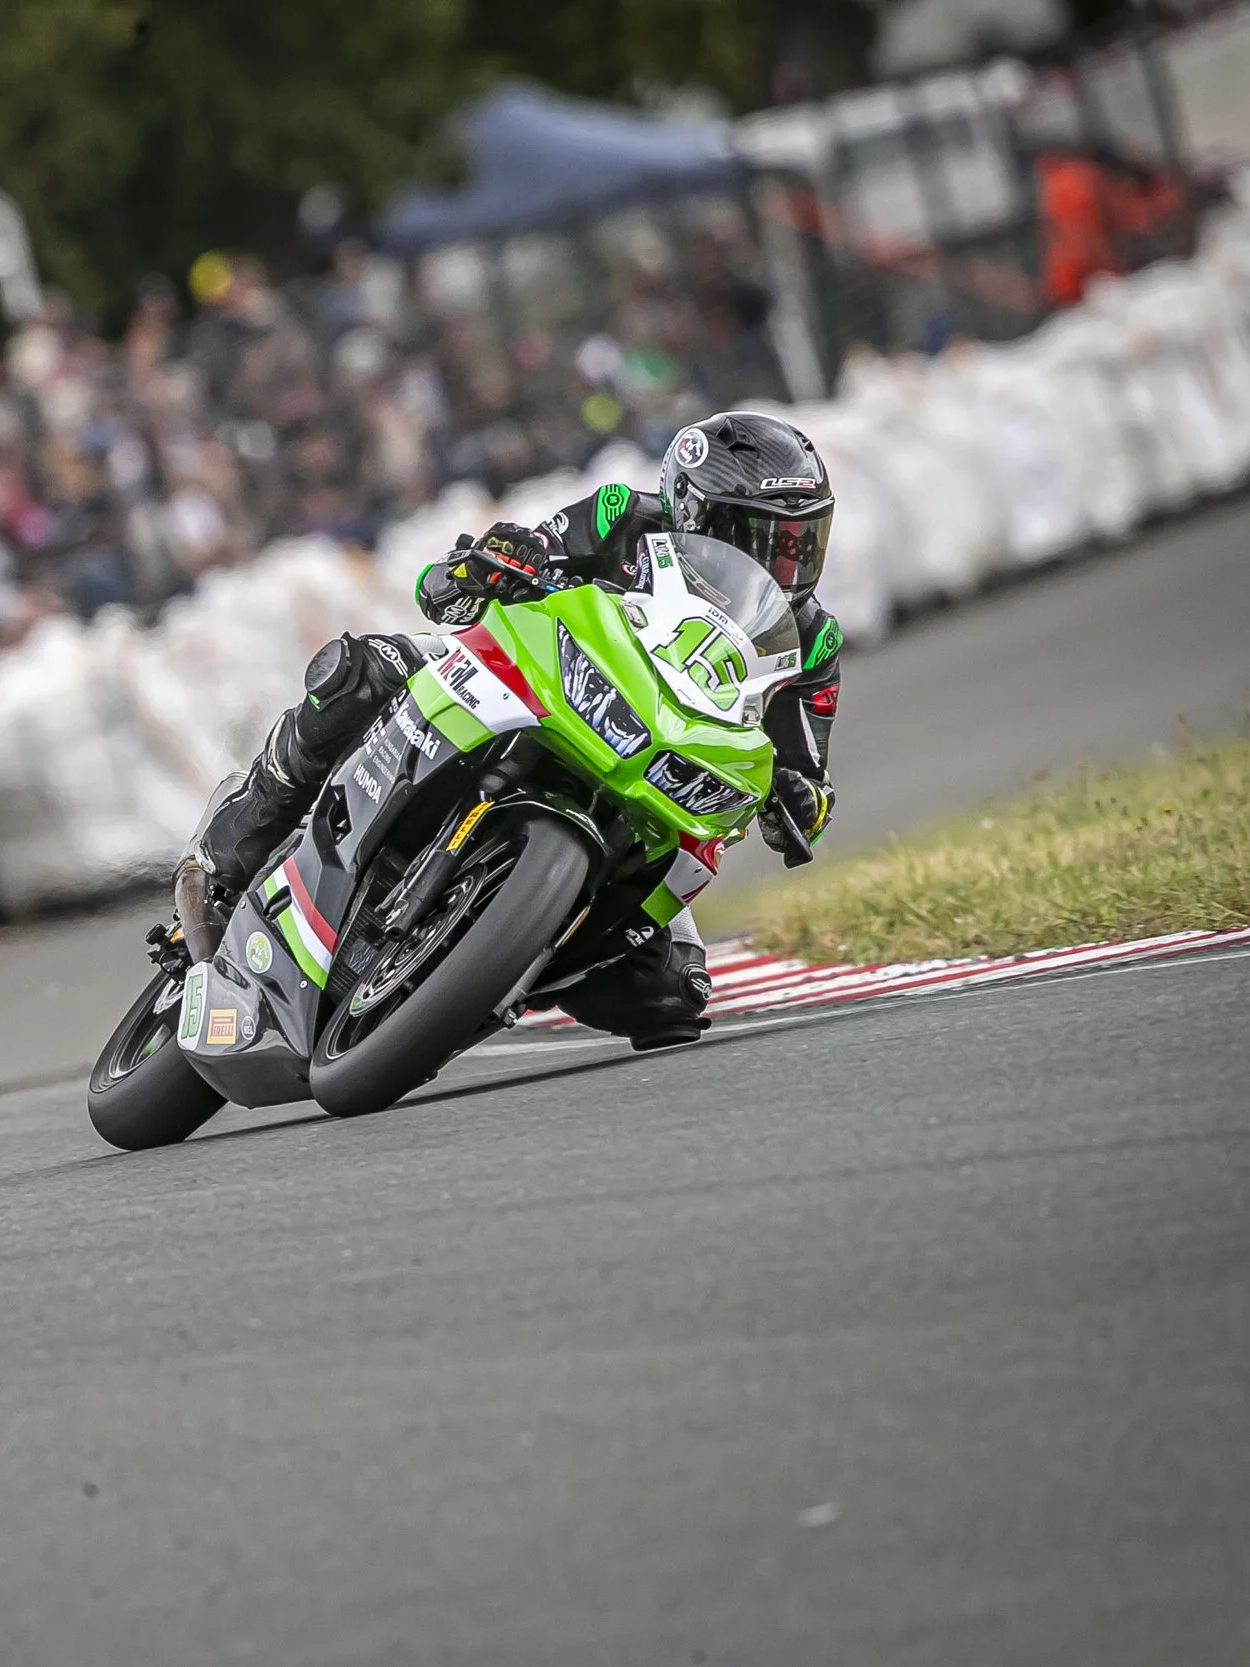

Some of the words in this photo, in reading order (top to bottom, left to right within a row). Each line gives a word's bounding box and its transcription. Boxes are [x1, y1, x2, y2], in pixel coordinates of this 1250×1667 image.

[650, 616, 748, 712] 15
[454, 685, 481, 710] RACING
[394, 701, 440, 760] Kawasaki
[353, 763, 382, 804] HUMDA
[180, 973, 204, 1040] 15
[210, 1016, 235, 1037] PIRELLI
